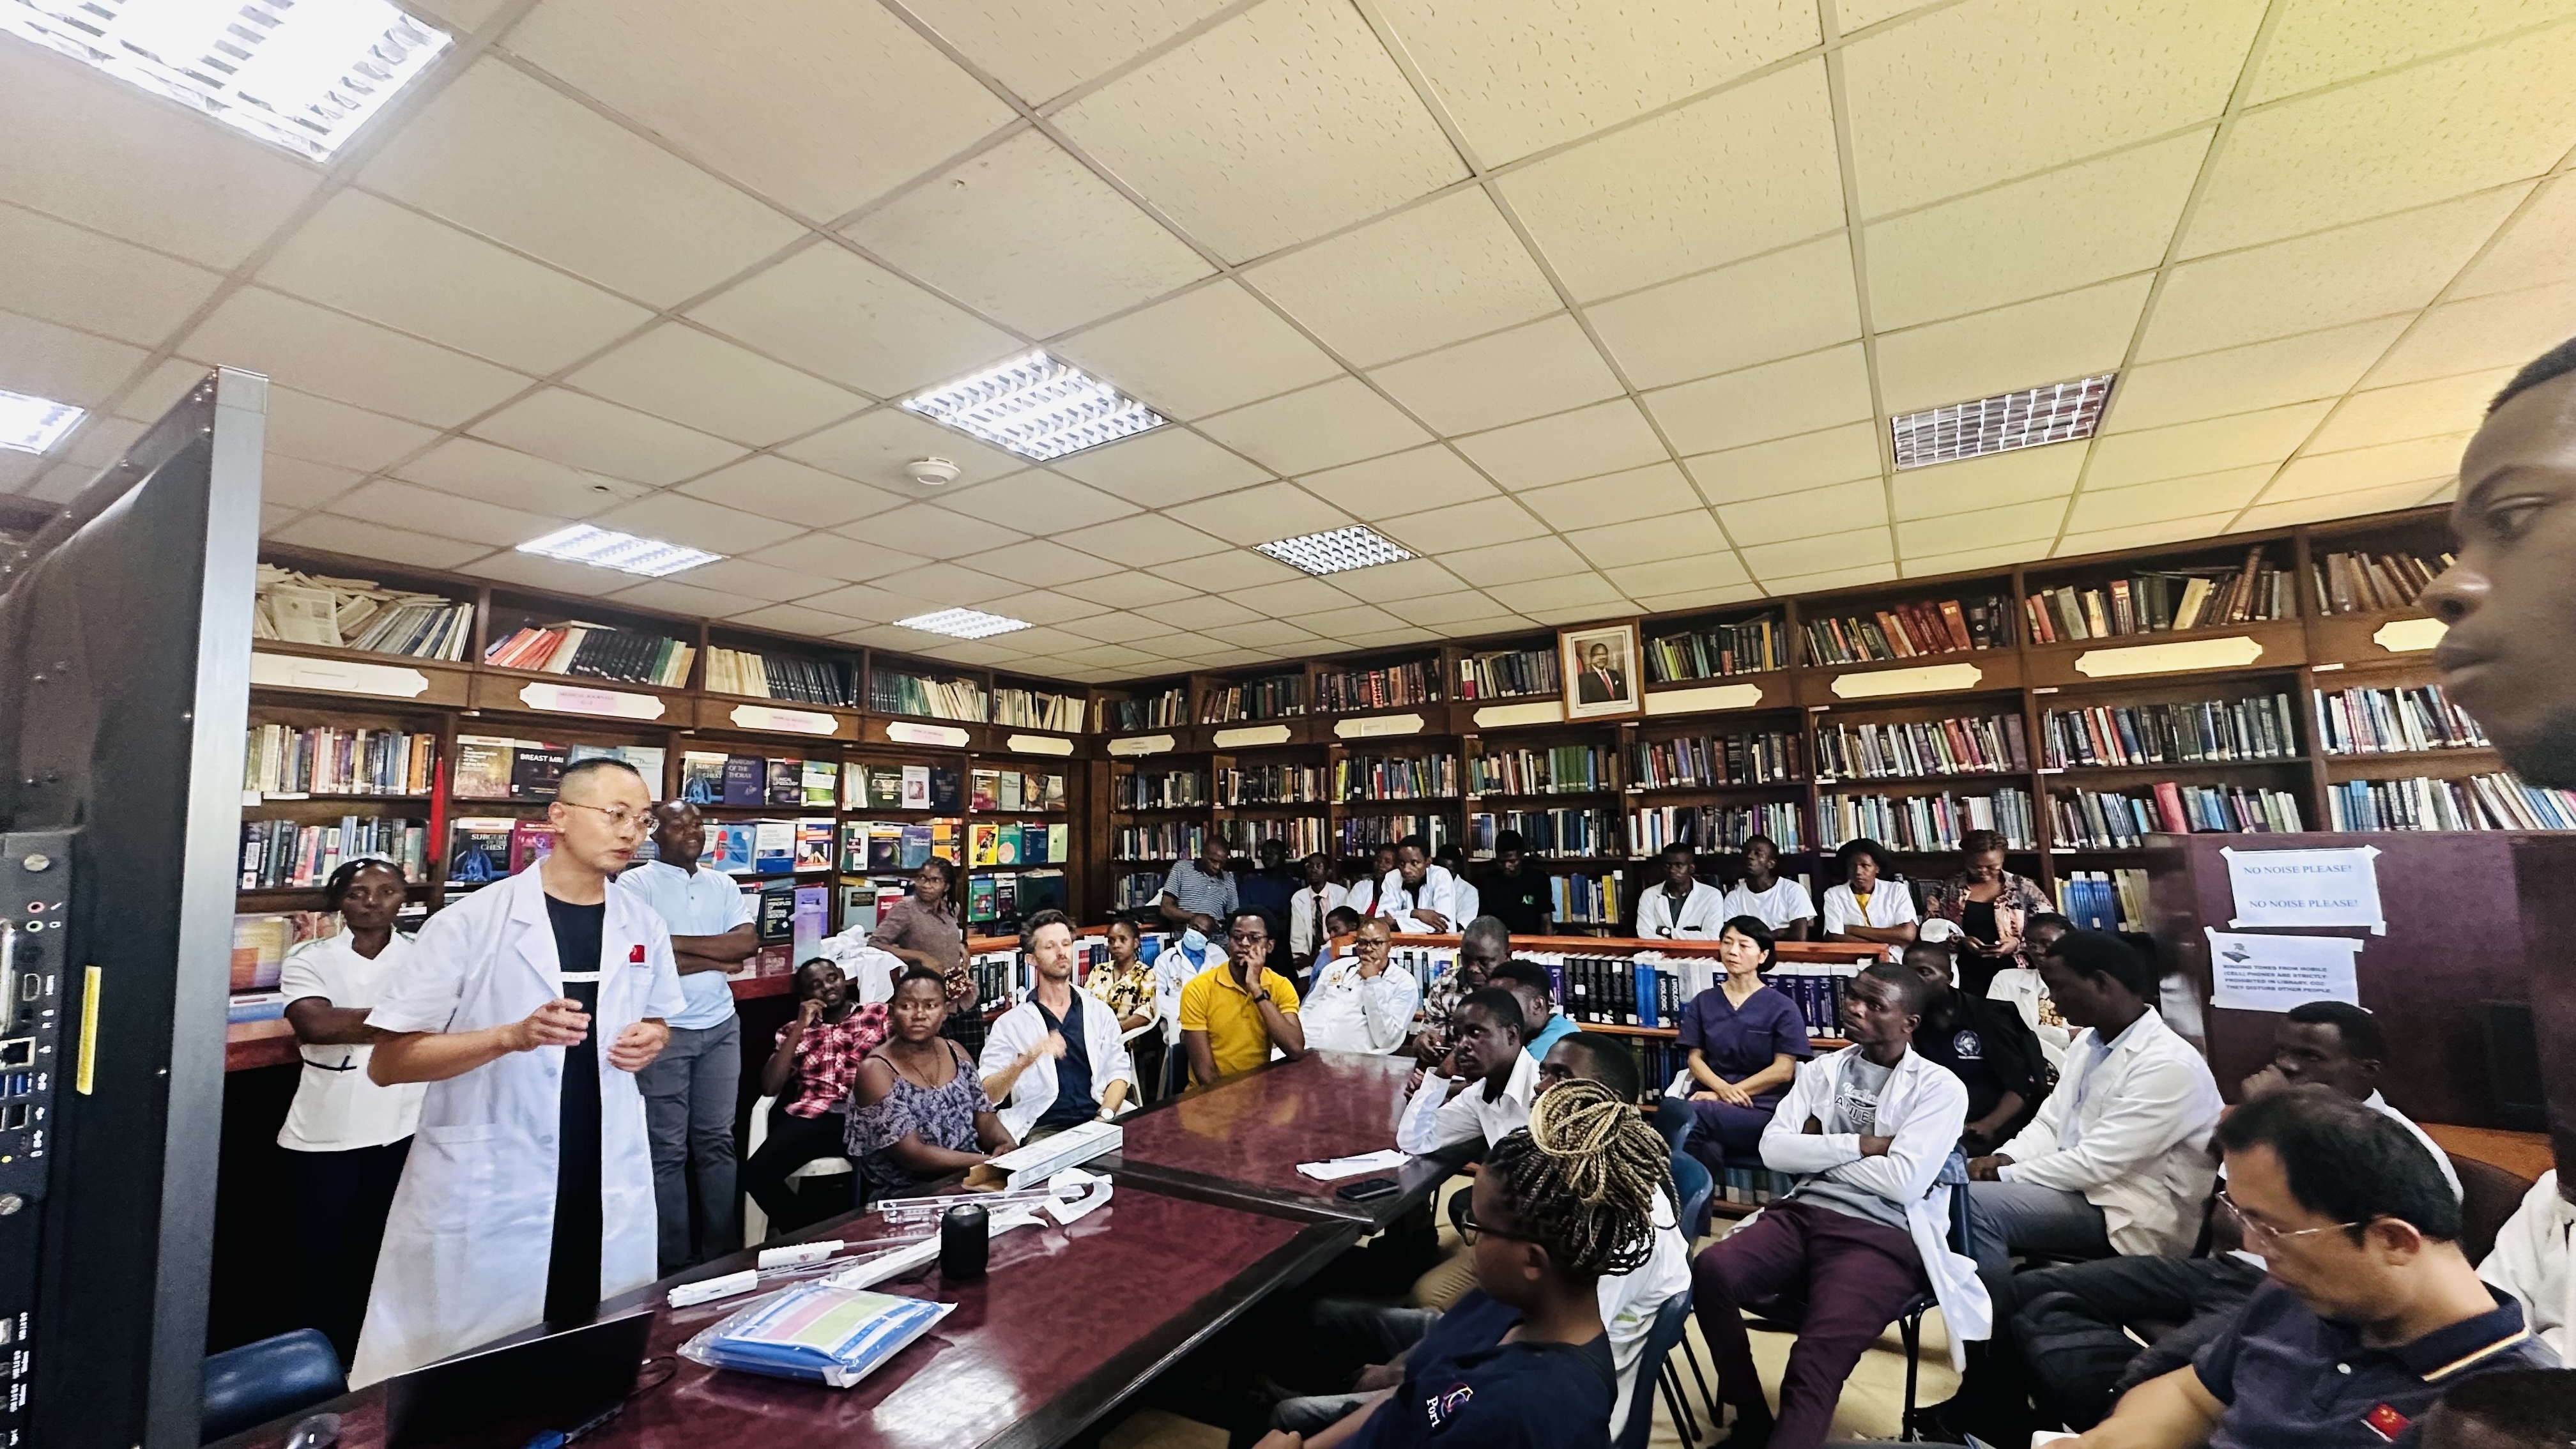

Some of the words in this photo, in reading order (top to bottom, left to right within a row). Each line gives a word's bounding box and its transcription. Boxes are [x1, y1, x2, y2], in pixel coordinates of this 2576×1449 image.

[520, 753, 548, 762] BREAST
[2244, 866, 2261, 875] NO
[2264, 866, 2300, 874] NOISE
[2303, 864, 2352, 873] PLEASE!
[2250, 900, 2267, 908] NO
[2270, 900, 2306, 908] NOISE
[2308, 899, 2358, 908] PLEASE!
[1671, 978, 1680, 1011] UROLOGIC
